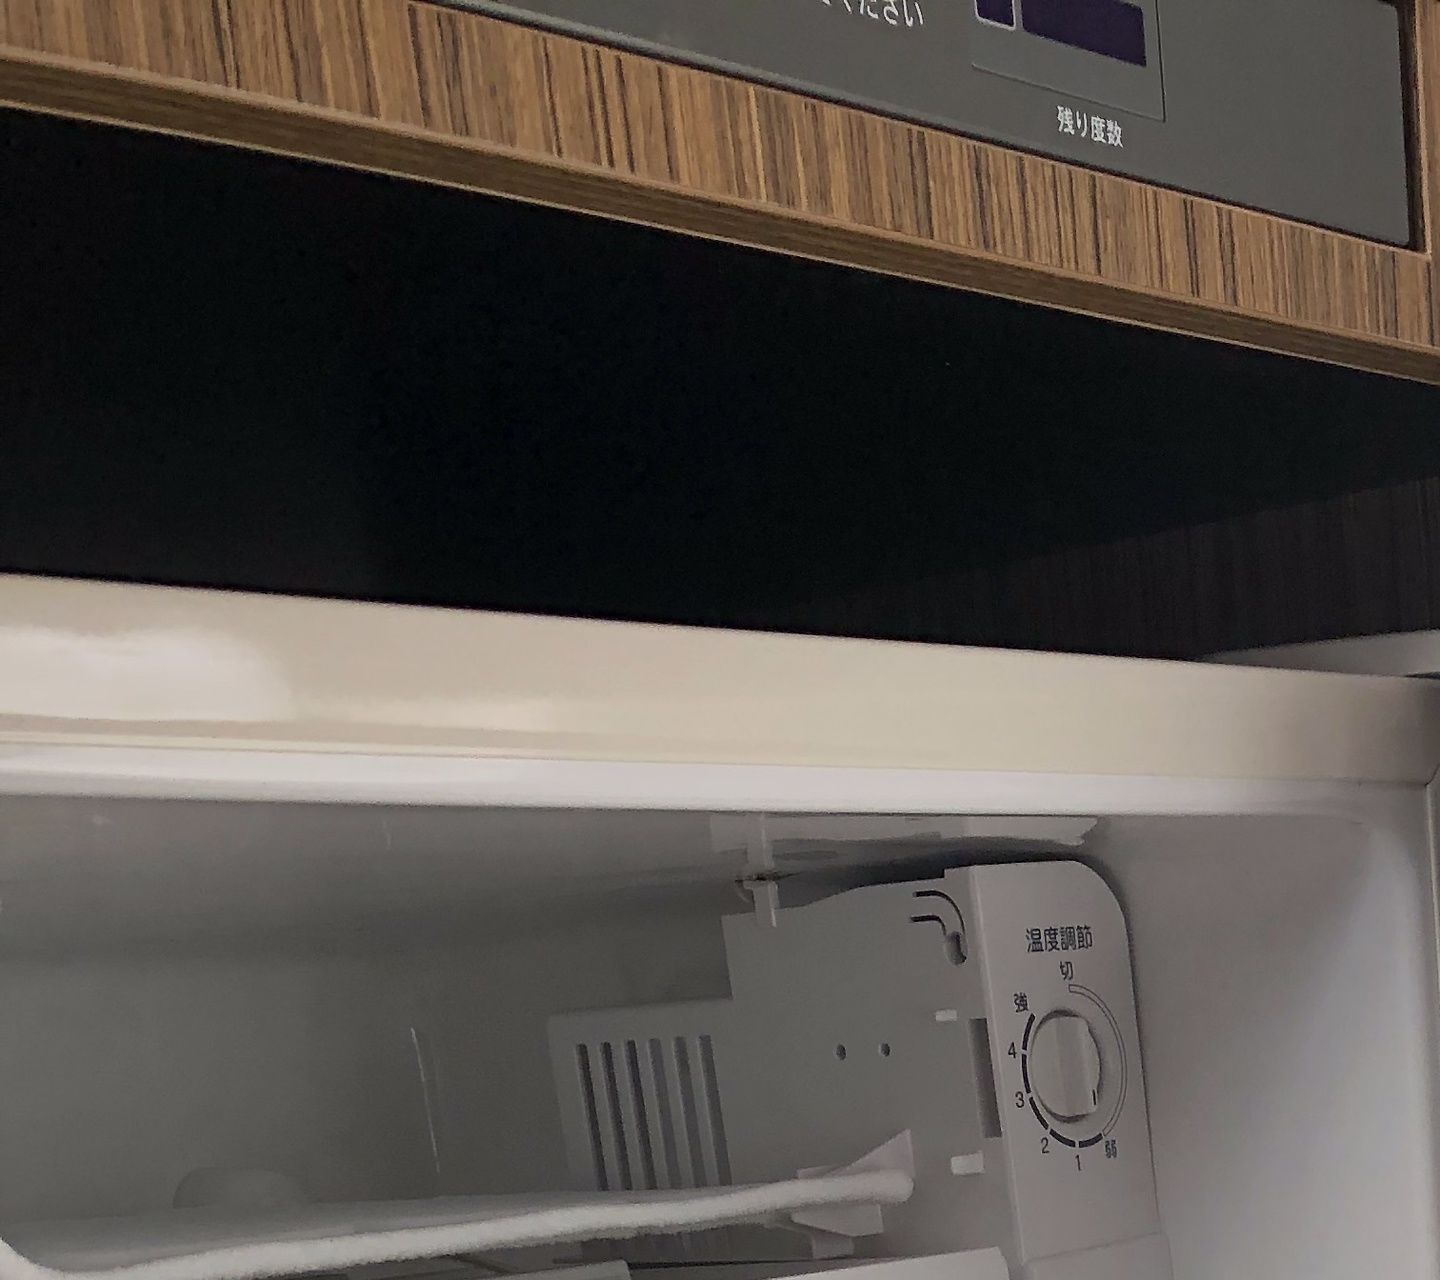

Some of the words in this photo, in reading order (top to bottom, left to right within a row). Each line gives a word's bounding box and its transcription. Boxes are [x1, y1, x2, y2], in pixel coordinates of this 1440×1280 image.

[1057, 105, 1123, 148] 残り度数
[1026, 926, 1093, 953] 温度調節
[1060, 961, 1074, 981] 切
[1014, 991, 1028, 1013] 強
[1008, 1042, 1017, 1059] 4
[1015, 1091, 1025, 1108] 3
[1040, 1137, 1050, 1154] 2
[1105, 1140, 1117, 1159] 弱
[1075, 1155, 1082, 1171] 1
